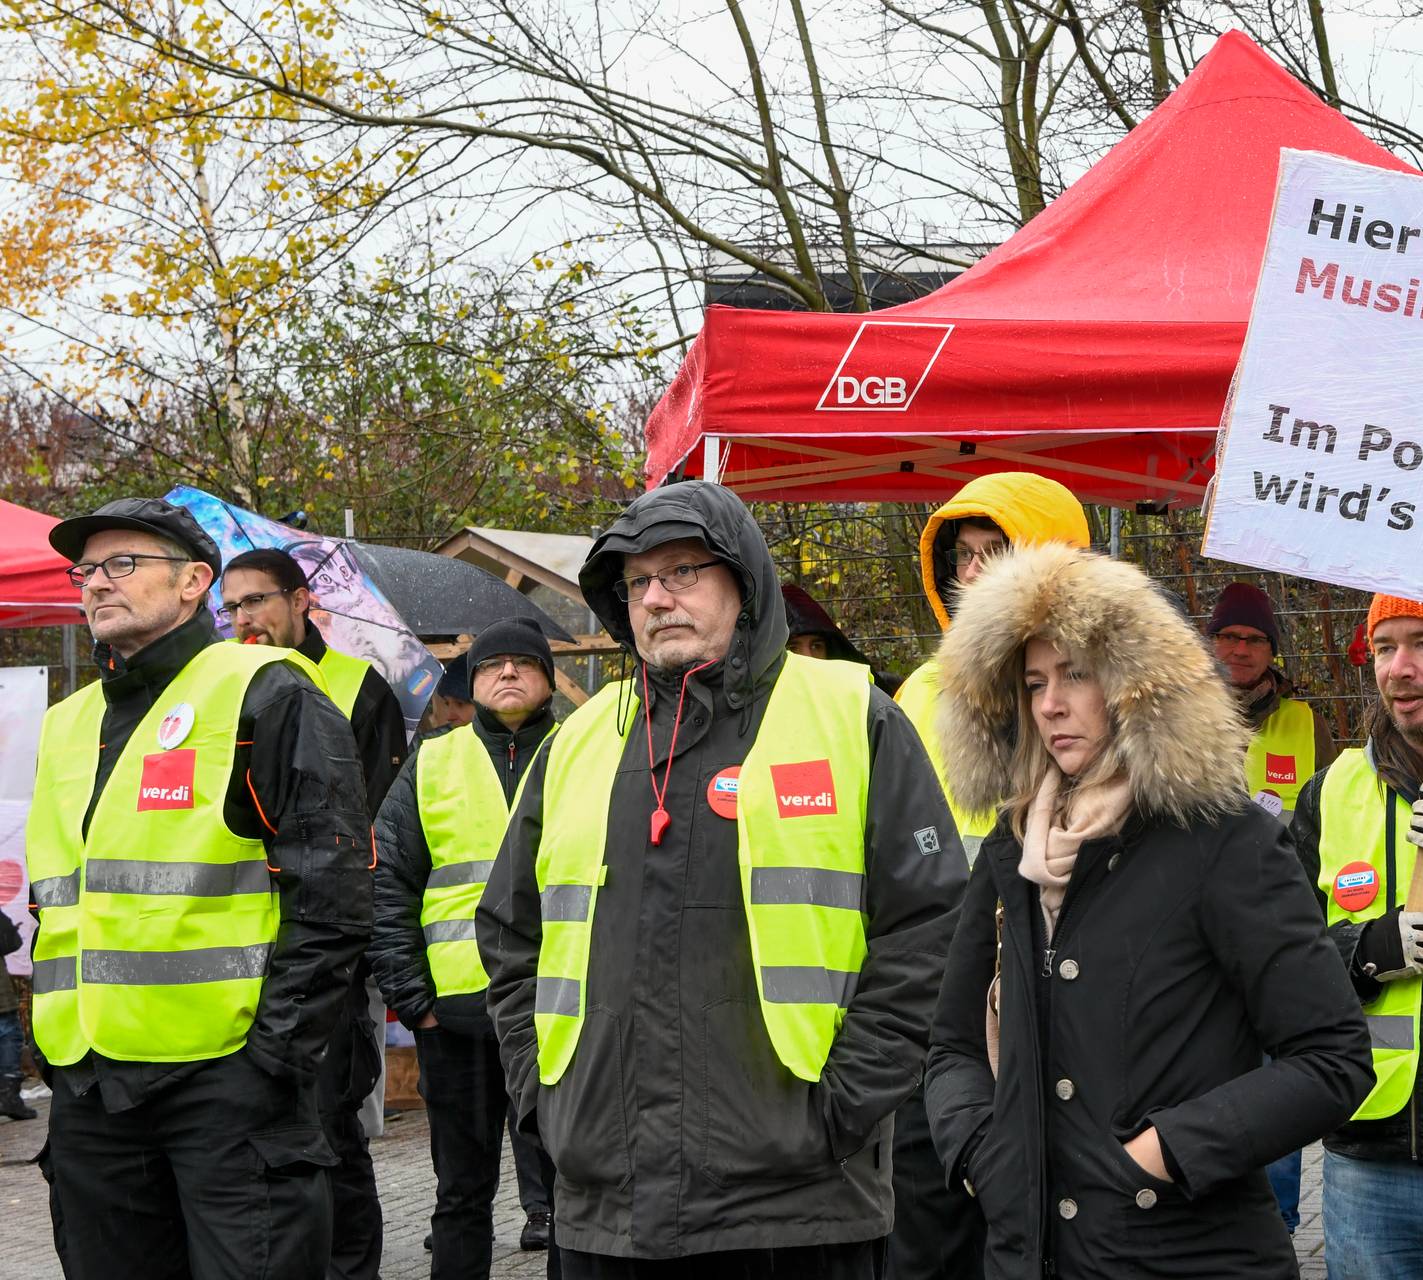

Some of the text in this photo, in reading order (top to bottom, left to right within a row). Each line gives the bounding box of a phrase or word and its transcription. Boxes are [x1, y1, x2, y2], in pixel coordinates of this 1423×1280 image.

[1308, 198, 1421, 254] Hier
[837, 376, 907, 405] DGB
[1262, 403, 1338, 454] Im
[1267, 770, 1295, 781] ver.di
[142, 785, 190, 801] ver.di
[780, 792, 832, 807] ver.di
